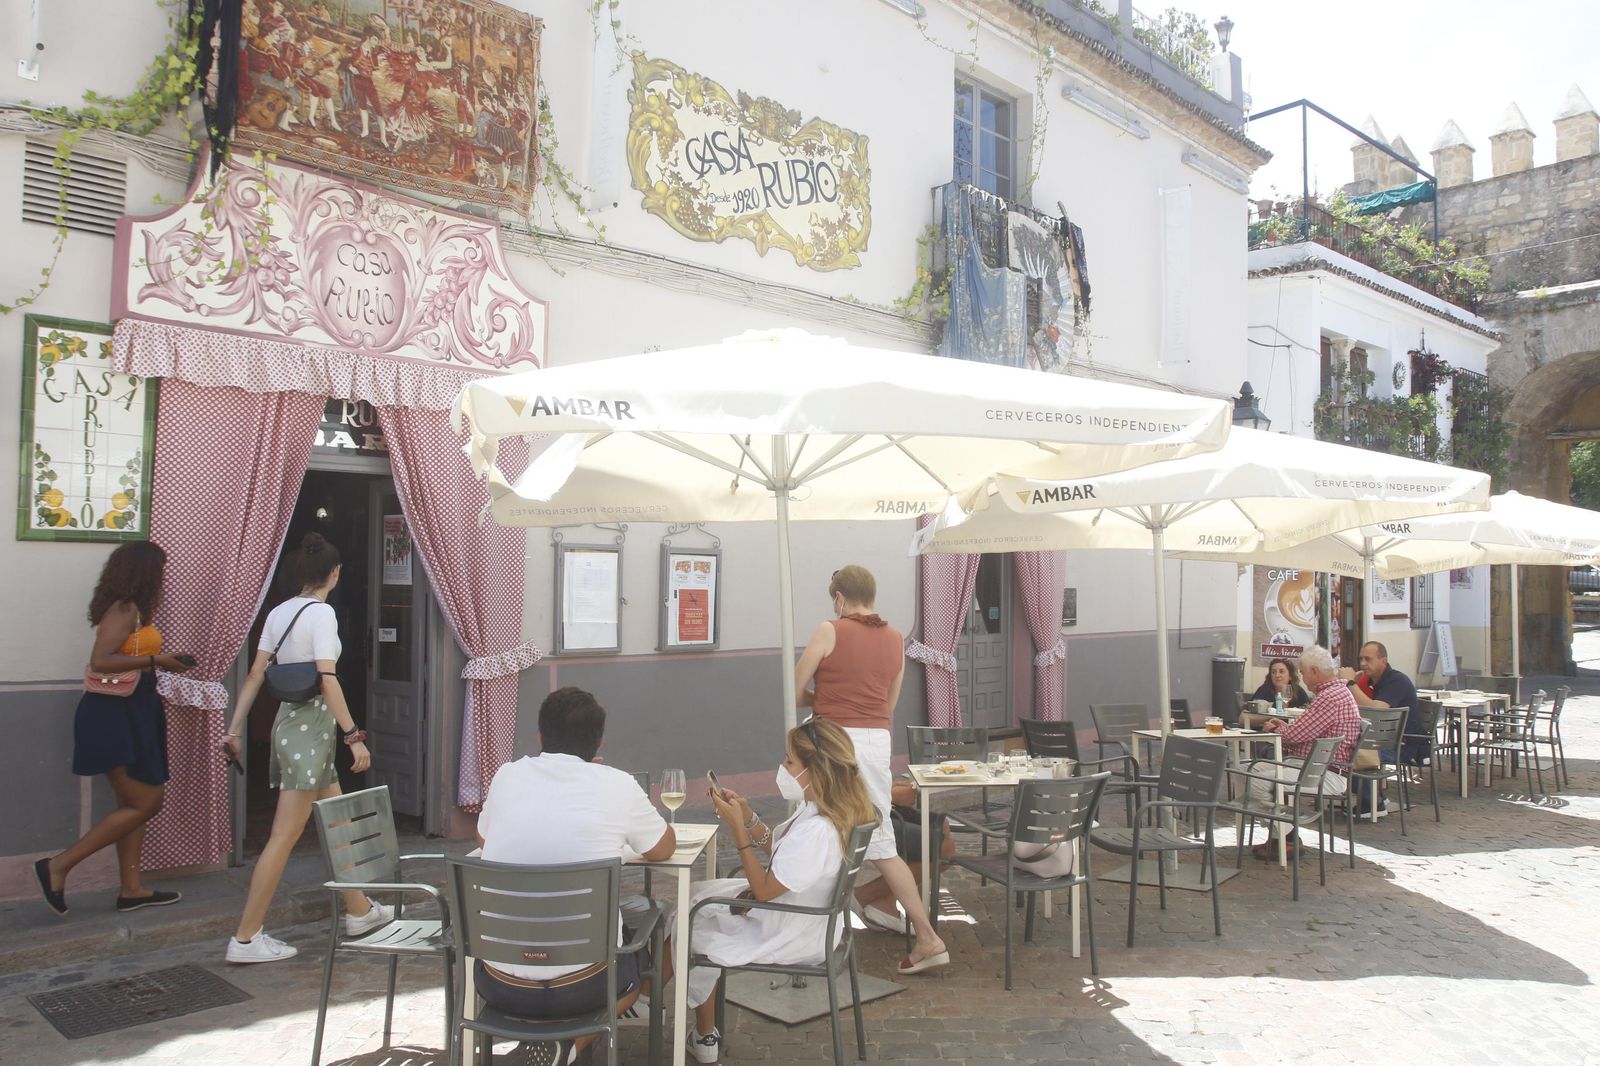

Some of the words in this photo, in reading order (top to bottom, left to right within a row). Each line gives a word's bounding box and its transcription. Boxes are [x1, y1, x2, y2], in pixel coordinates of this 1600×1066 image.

[686, 126, 757, 180] CASA
[710, 188, 731, 203] Desde
[732, 187, 760, 214] 1920
[43, 368, 138, 411] CASA
[531, 395, 636, 420] AMBAR
[985, 409, 1082, 425] CERVECEROS
[81, 394, 102, 528] RUBIO
[1032, 484, 1096, 504] AMBAR
[1315, 479, 1382, 489] CERVECEROS
